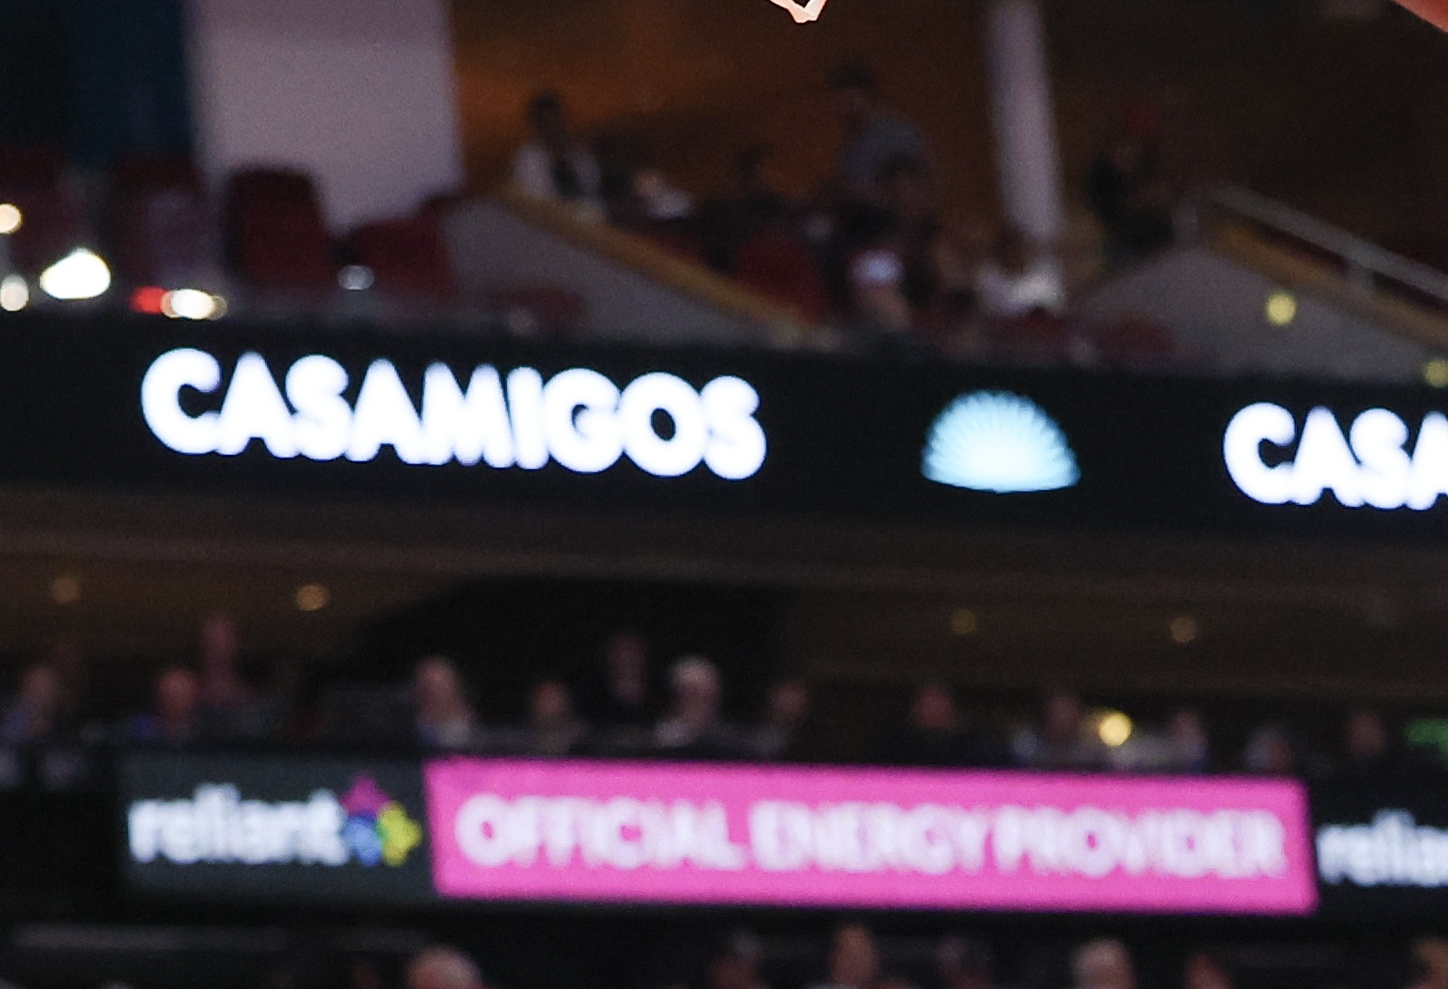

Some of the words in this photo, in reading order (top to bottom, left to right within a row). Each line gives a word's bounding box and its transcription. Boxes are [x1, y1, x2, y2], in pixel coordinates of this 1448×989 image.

[140, 347, 766, 480] CASAMIGOS
[127, 783, 350, 866] reliant
[456, 794, 746, 871] OFFICIAL
[751, 800, 992, 875] ENERGY
[994, 806, 1288, 878] PROVIDER
